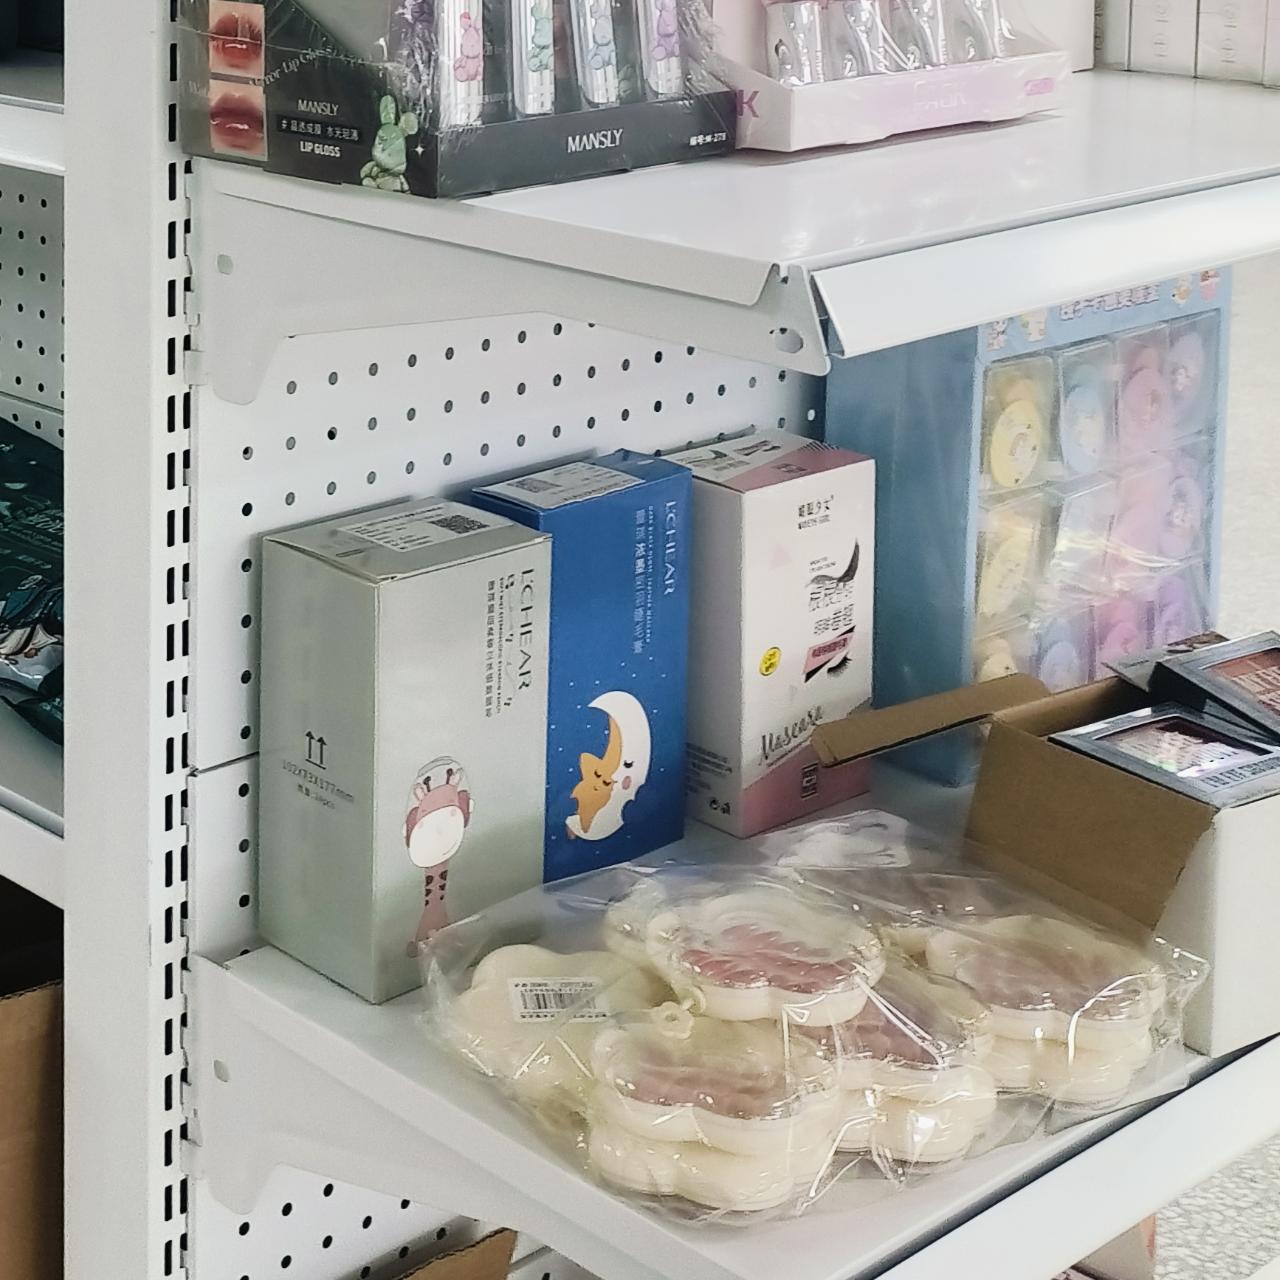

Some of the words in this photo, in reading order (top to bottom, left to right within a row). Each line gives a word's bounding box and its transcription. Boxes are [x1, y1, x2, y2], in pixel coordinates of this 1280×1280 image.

[297, 98, 340, 117] MANSLY
[299, 140, 314, 153] LIP
[313, 141, 342, 158] GLOSS
[567, 128, 624, 153] MANSLY
[518, 568, 536, 691] L'CHEAR
